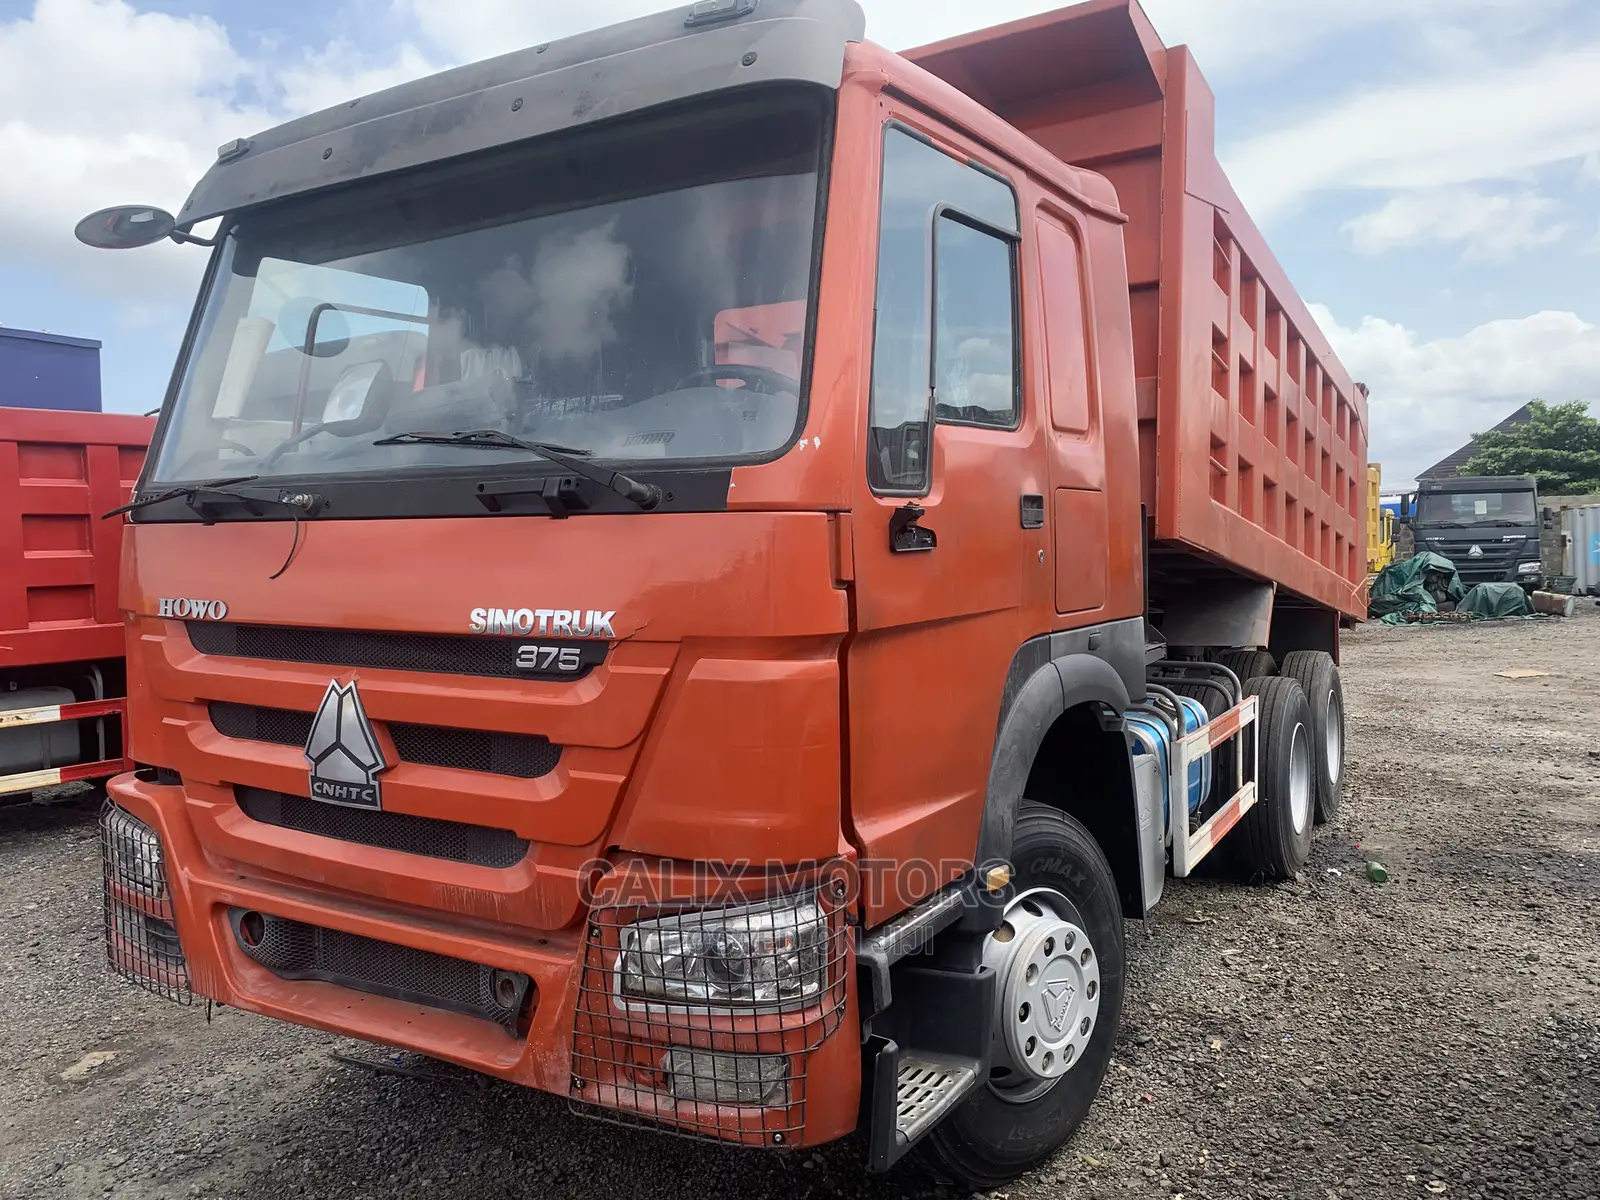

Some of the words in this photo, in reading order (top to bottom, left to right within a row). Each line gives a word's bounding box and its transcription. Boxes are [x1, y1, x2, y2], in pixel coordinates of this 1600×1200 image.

[158, 597, 227, 620] HOWO
[469, 607, 616, 638] SINOTRUK
[515, 645, 581, 671] 375
[313, 781, 374, 802] CNHTC
